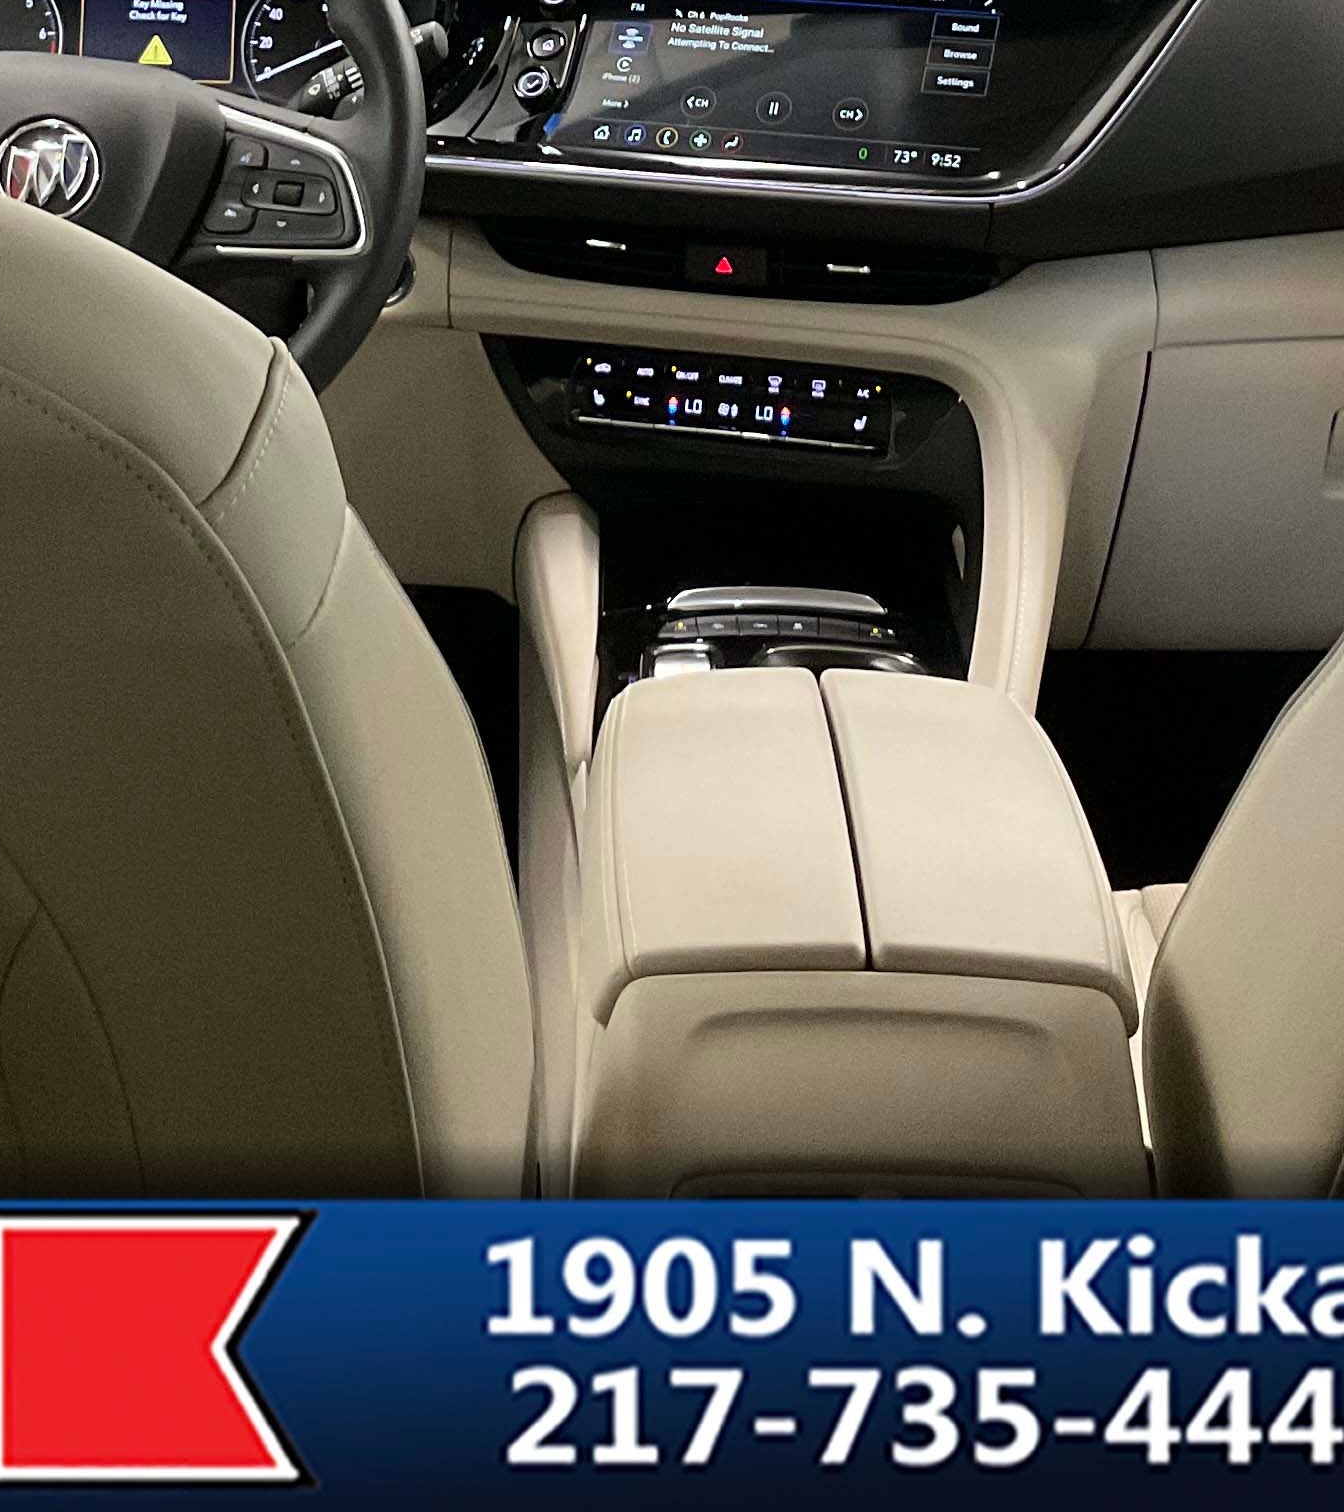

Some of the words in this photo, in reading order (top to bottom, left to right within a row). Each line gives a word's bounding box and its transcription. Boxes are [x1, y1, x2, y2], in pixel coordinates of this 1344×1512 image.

[150, 0, 184, 11] Missing
[630, 2, 646, 12] FM
[129, 9, 156, 20] Check
[157, 11, 170, 20] for
[171, 11, 187, 23] Key
[268, 7, 284, 20] 40
[39, 28, 47, 40] 6
[670, 22, 687, 33] No
[688, 23, 730, 37] Satellite
[732, 26, 765, 39] Signal
[951, 22, 980, 33] Sound
[258, 36, 273, 49] 20
[667, 36, 716, 50] Attempting
[719, 40, 730, 50] To
[943, 48, 978, 60] Browse
[937, 75, 974, 89] Settings
[694, 98, 709, 108] CH
[839, 109, 854, 119] CH
[931, 153, 961, 168] 9:52
[856, 388, 870, 399] A/C
[684, 398, 703, 415] LO
[755, 405, 774, 422] LO
